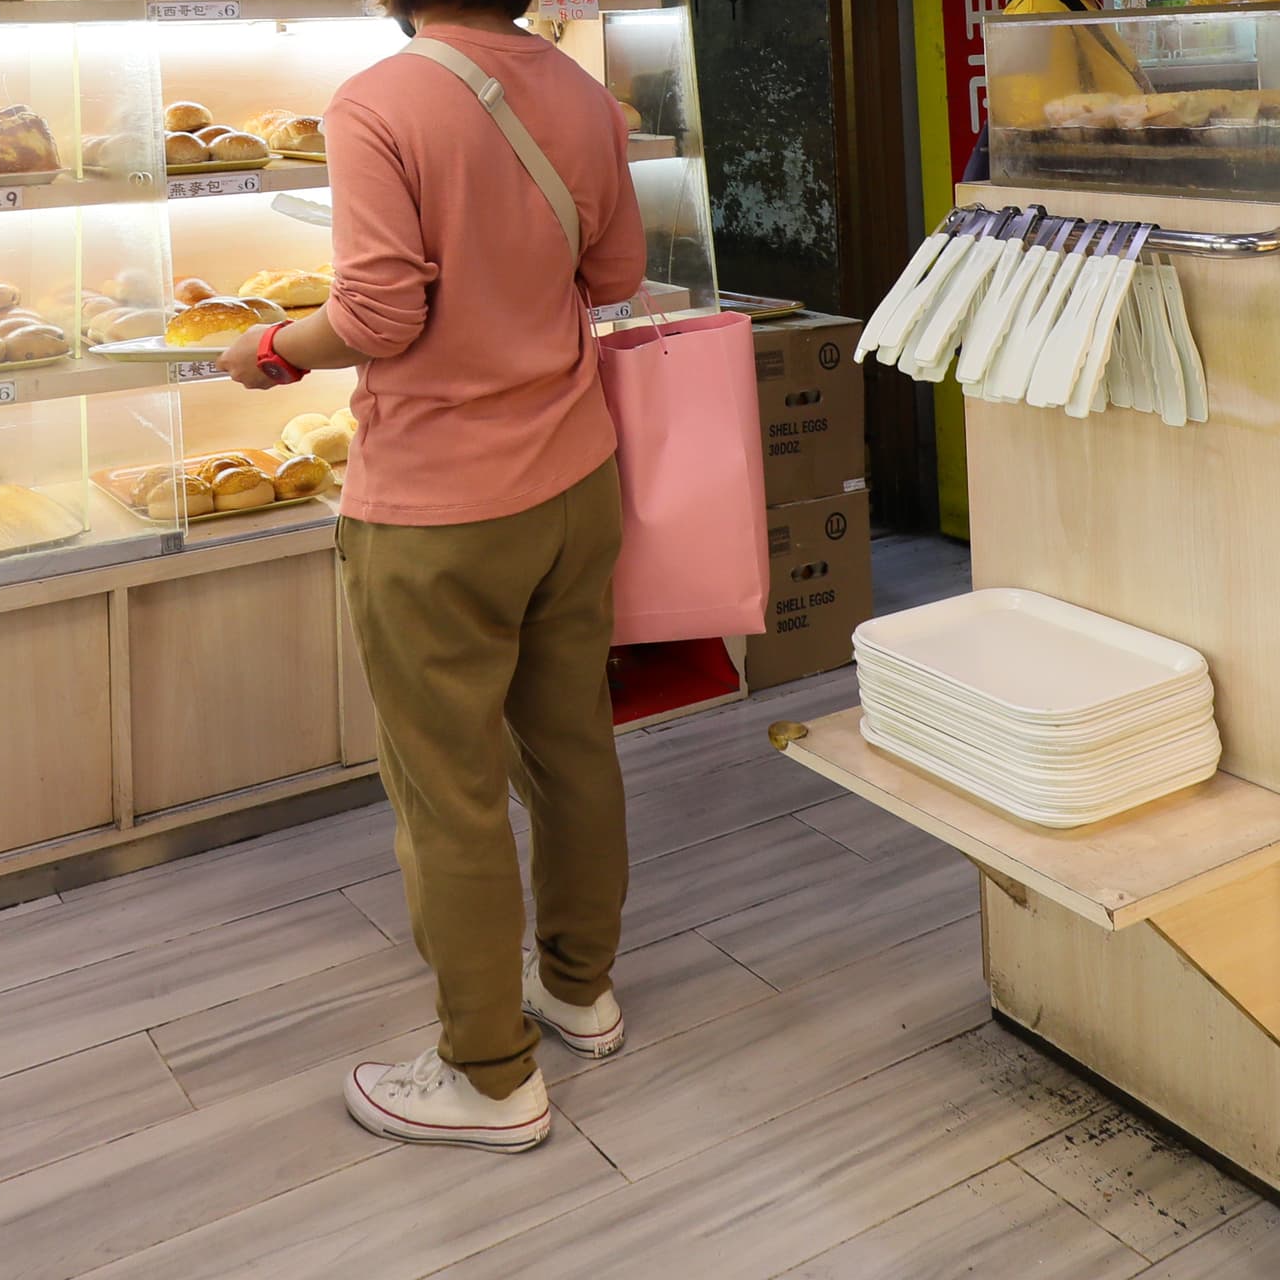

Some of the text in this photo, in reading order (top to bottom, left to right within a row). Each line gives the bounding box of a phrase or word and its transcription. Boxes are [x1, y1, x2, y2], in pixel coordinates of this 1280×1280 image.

[170, 177, 256, 198] 燕麥包 $6
[769, 418, 828, 438] SHELL EGGS
[776, 590, 835, 616] SHELL EGGS
